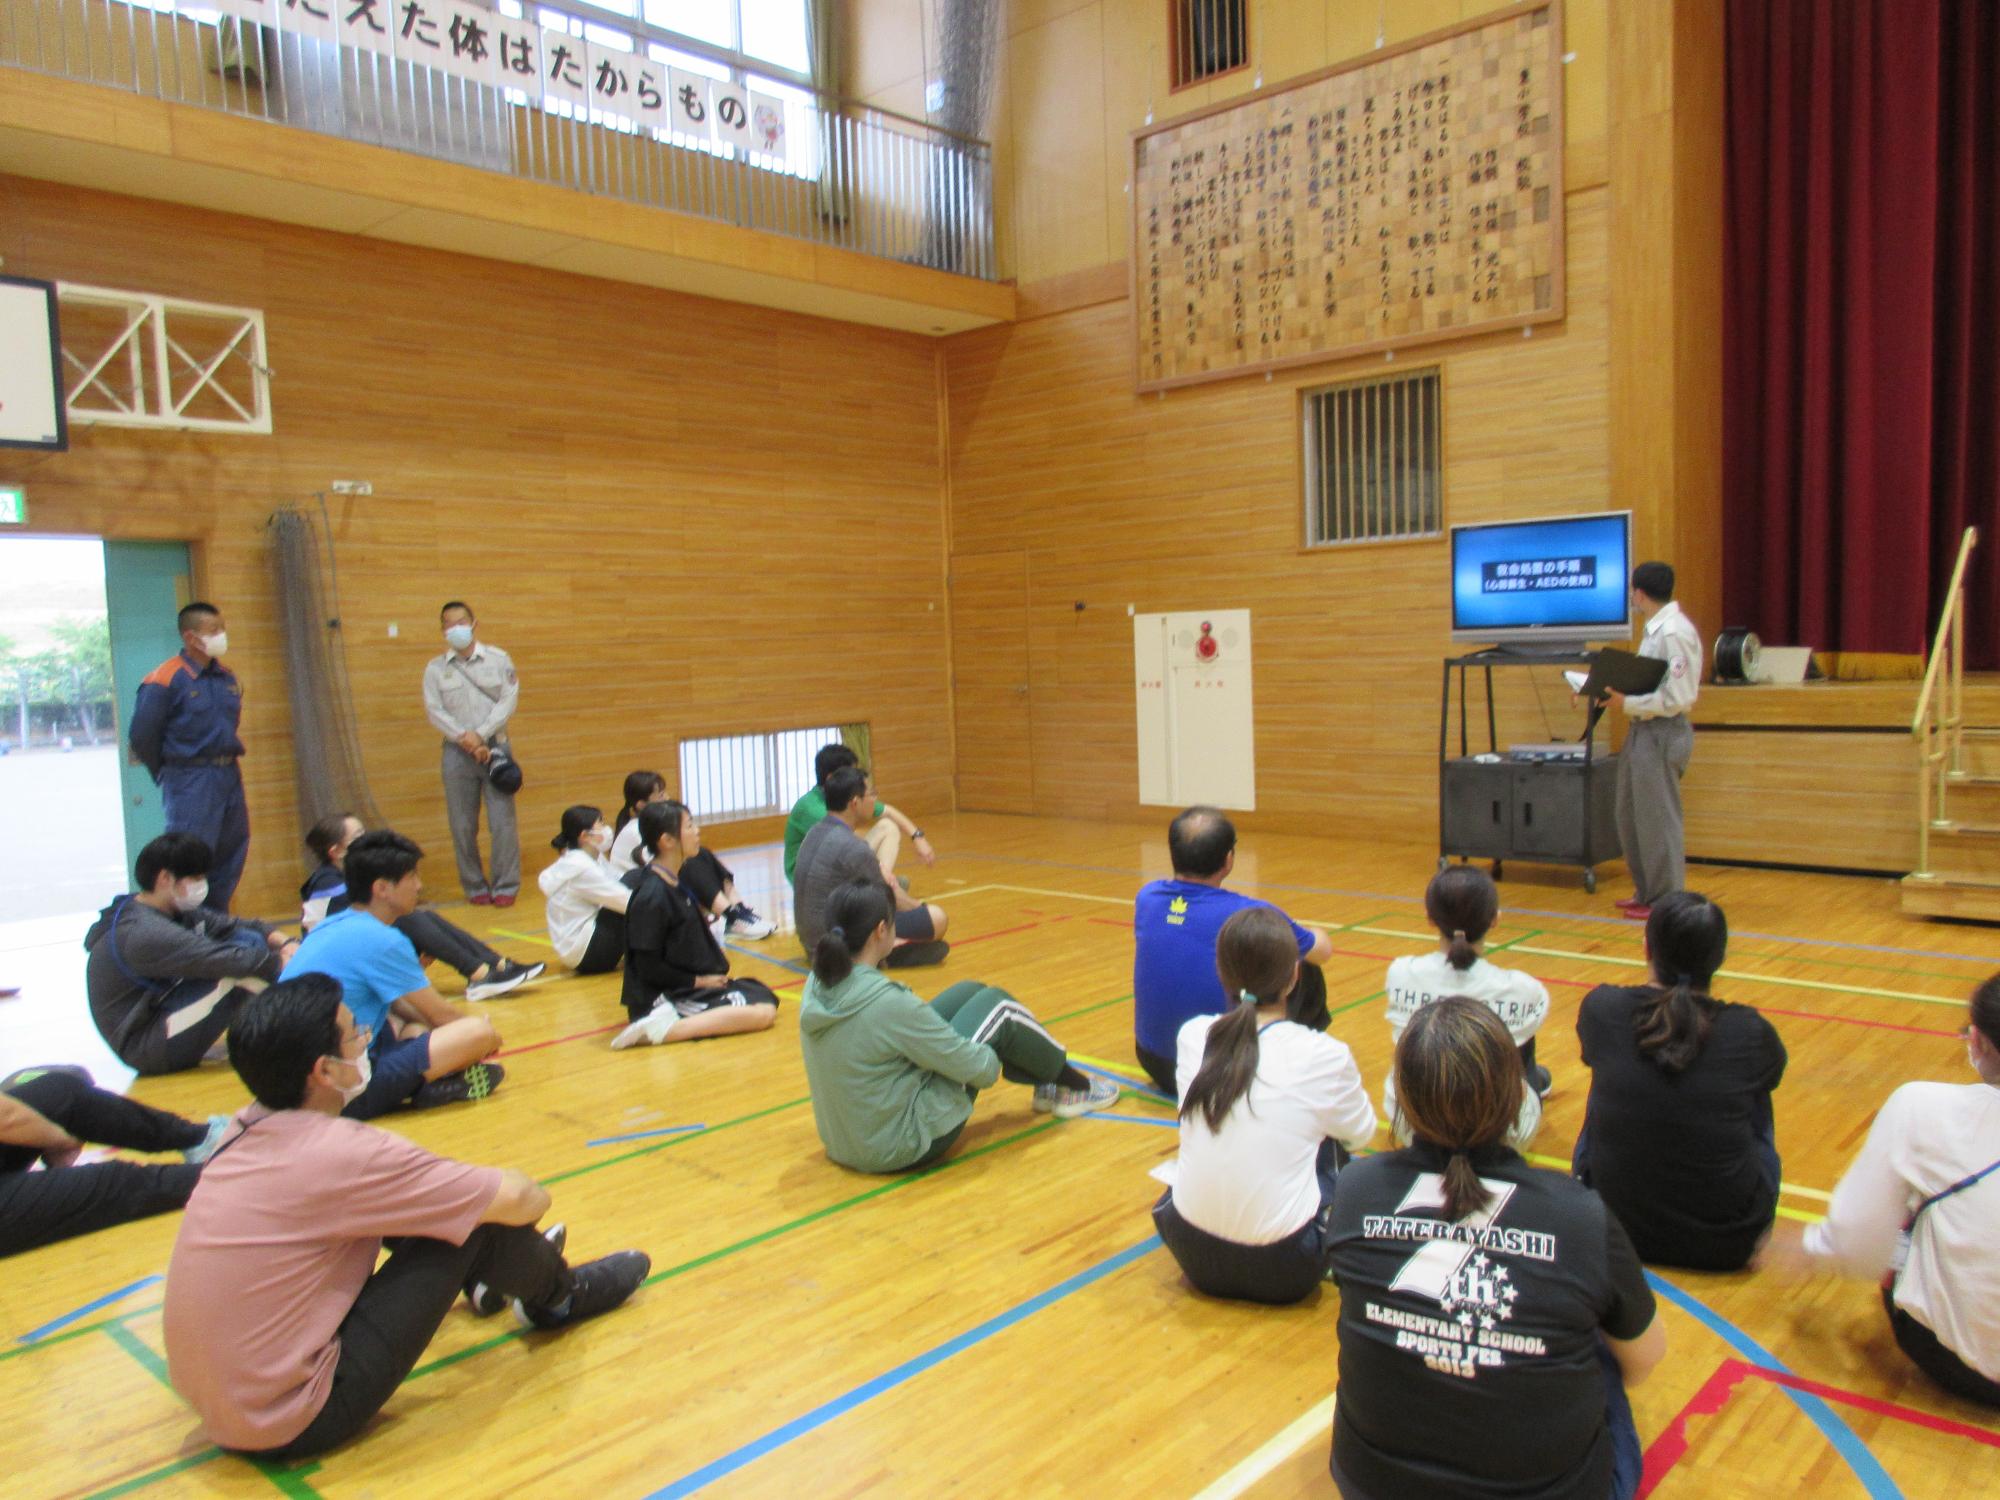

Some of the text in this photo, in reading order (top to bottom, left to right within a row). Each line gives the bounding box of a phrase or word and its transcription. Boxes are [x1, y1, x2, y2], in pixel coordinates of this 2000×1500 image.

[249, 0, 747, 131] えた体はたからもの
[1363, 1214, 1556, 1262] TATEBAYASHI
[1365, 1302, 1547, 1356] ELEMENTARY SCHOOL
[1396, 1330, 1463, 1359] SPORTS
